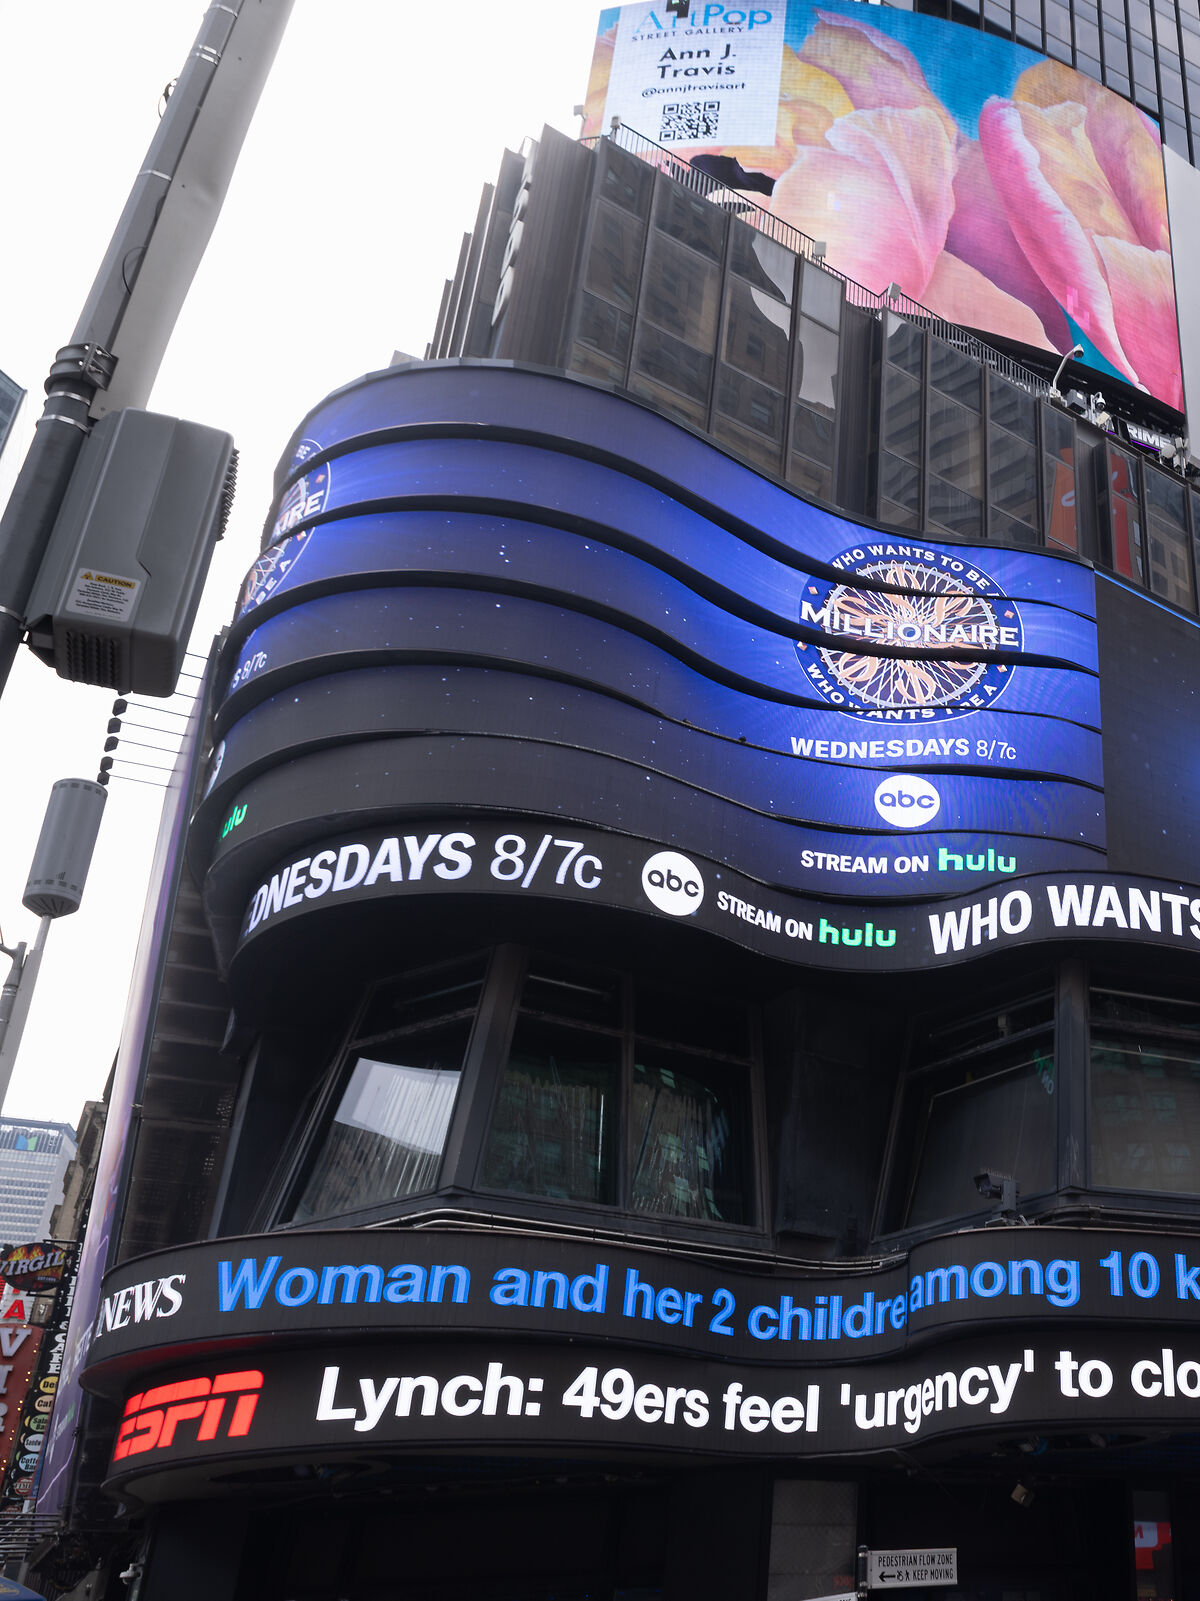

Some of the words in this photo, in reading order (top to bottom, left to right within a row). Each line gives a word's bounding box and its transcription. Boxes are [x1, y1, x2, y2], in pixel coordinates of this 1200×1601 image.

[631, 30, 677, 42] STREET
[685, 26, 745, 37] GALLERY
[659, 47, 711, 62] Ann
[721, 43, 737, 59] J.
[657, 62, 736, 79] Travis
[641, 82, 747, 98] @annjtravisart
[832, 548, 866, 571] WHO
[867, 544, 935, 562] WANTS
[940, 555, 964, 572] TO
[966, 567, 991, 591] BE
[97, 576, 132, 588] CAUTION
[800, 600, 1020, 648] MILLIONAIRE
[806, 662, 845, 704] WHO
[983, 684, 997, 697] A
[791, 737, 970, 759] WEDNESDAYS
[976, 739, 1017, 760] 8/7c
[878, 790, 936, 809] abc
[219, 803, 248, 841] ulu
[801, 850, 888, 874] STREAM
[894, 855, 929, 875] ON
[938, 847, 1017, 874] hulu
[489, 834, 603, 889] 8/7c
[647, 868, 700, 898] abc
[716, 890, 781, 934] STREAM
[785, 918, 813, 941] ON
[818, 918, 897, 947] hulu
[928, 890, 1033, 955] WHO
[96, 1274, 186, 1338] NEWS
[217, 1255, 471, 1312] Woman
[489, 1263, 609, 1313] and
[622, 1267, 703, 1328] her
[708, 1288, 736, 1337] 2
[909, 1259, 1081, 1313] among
[1100, 1250, 1161, 1299] 10
[113, 1369, 264, 1463] ESPN
[316, 1361, 545, 1433] Lynch:
[562, 1365, 710, 1429] 49ers
[723, 1381, 821, 1434] feel
[841, 1349, 1035, 1434] 'urgency'
[1055, 1350, 1114, 1398] to
[878, 1554, 918, 1567] PEDESTRIAN
[919, 1554, 936, 1566] FLOW
[937, 1553, 953, 1565] ZONE
[912, 1569, 929, 1580] KEEP
[930, 1568, 954, 1580] MOVING
